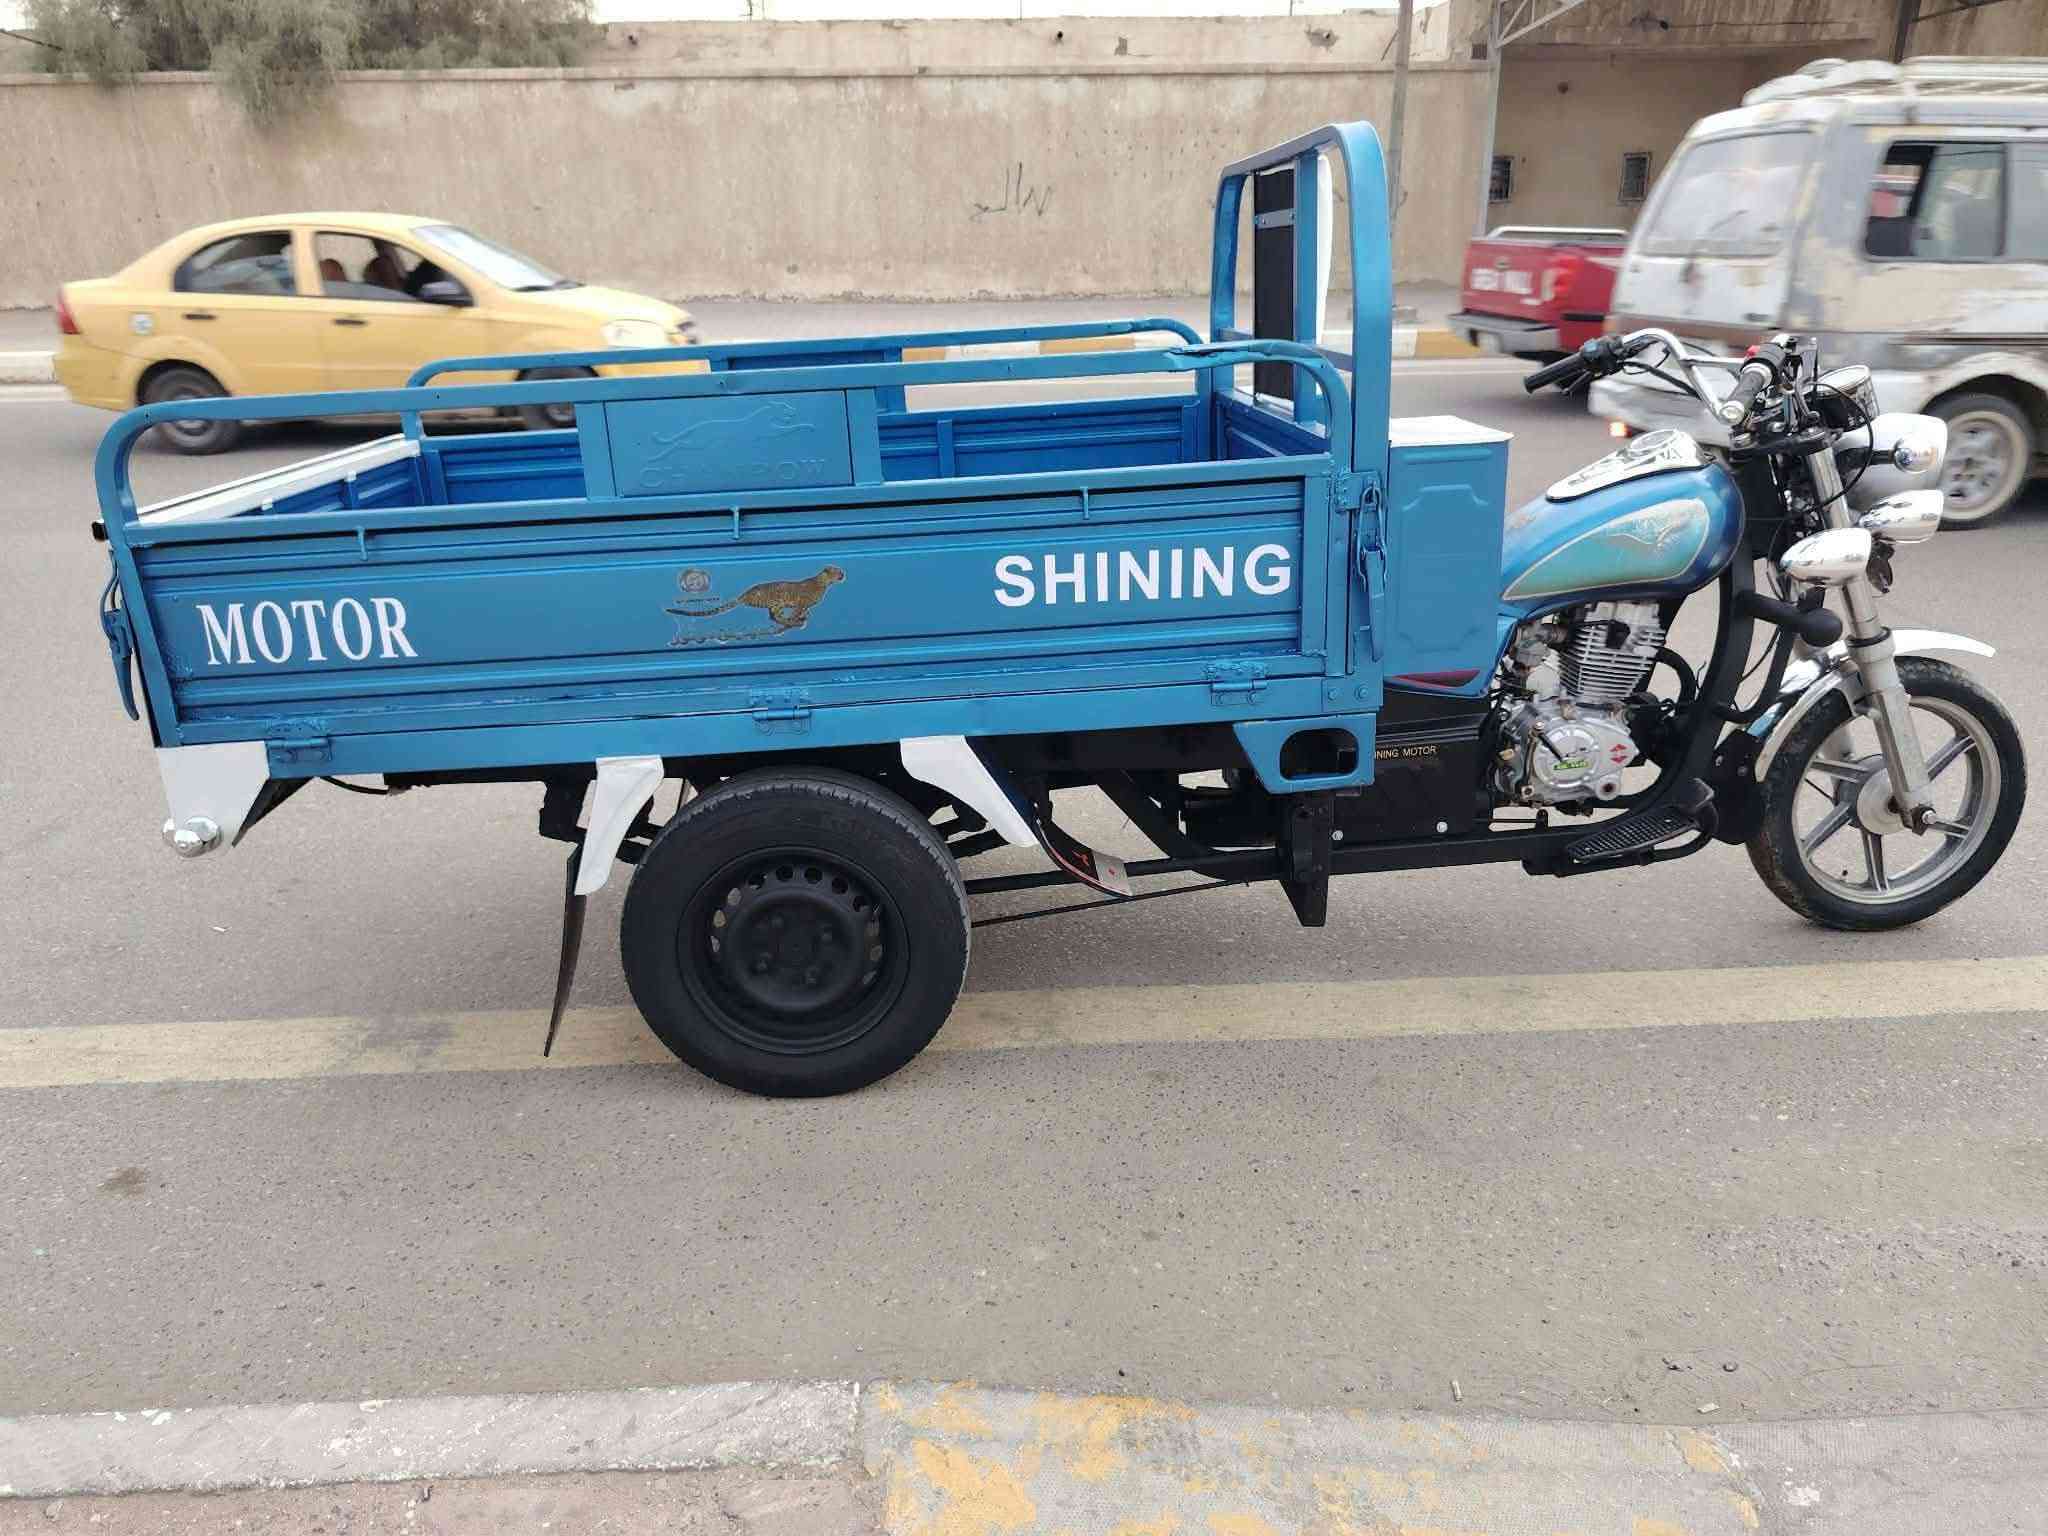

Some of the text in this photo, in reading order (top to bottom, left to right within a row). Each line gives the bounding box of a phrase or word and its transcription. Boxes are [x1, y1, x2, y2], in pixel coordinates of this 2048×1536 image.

[993, 543, 1291, 607] SHINING
[195, 597, 419, 665] MOTOR
[1402, 745, 1437, 757] MOTOR
